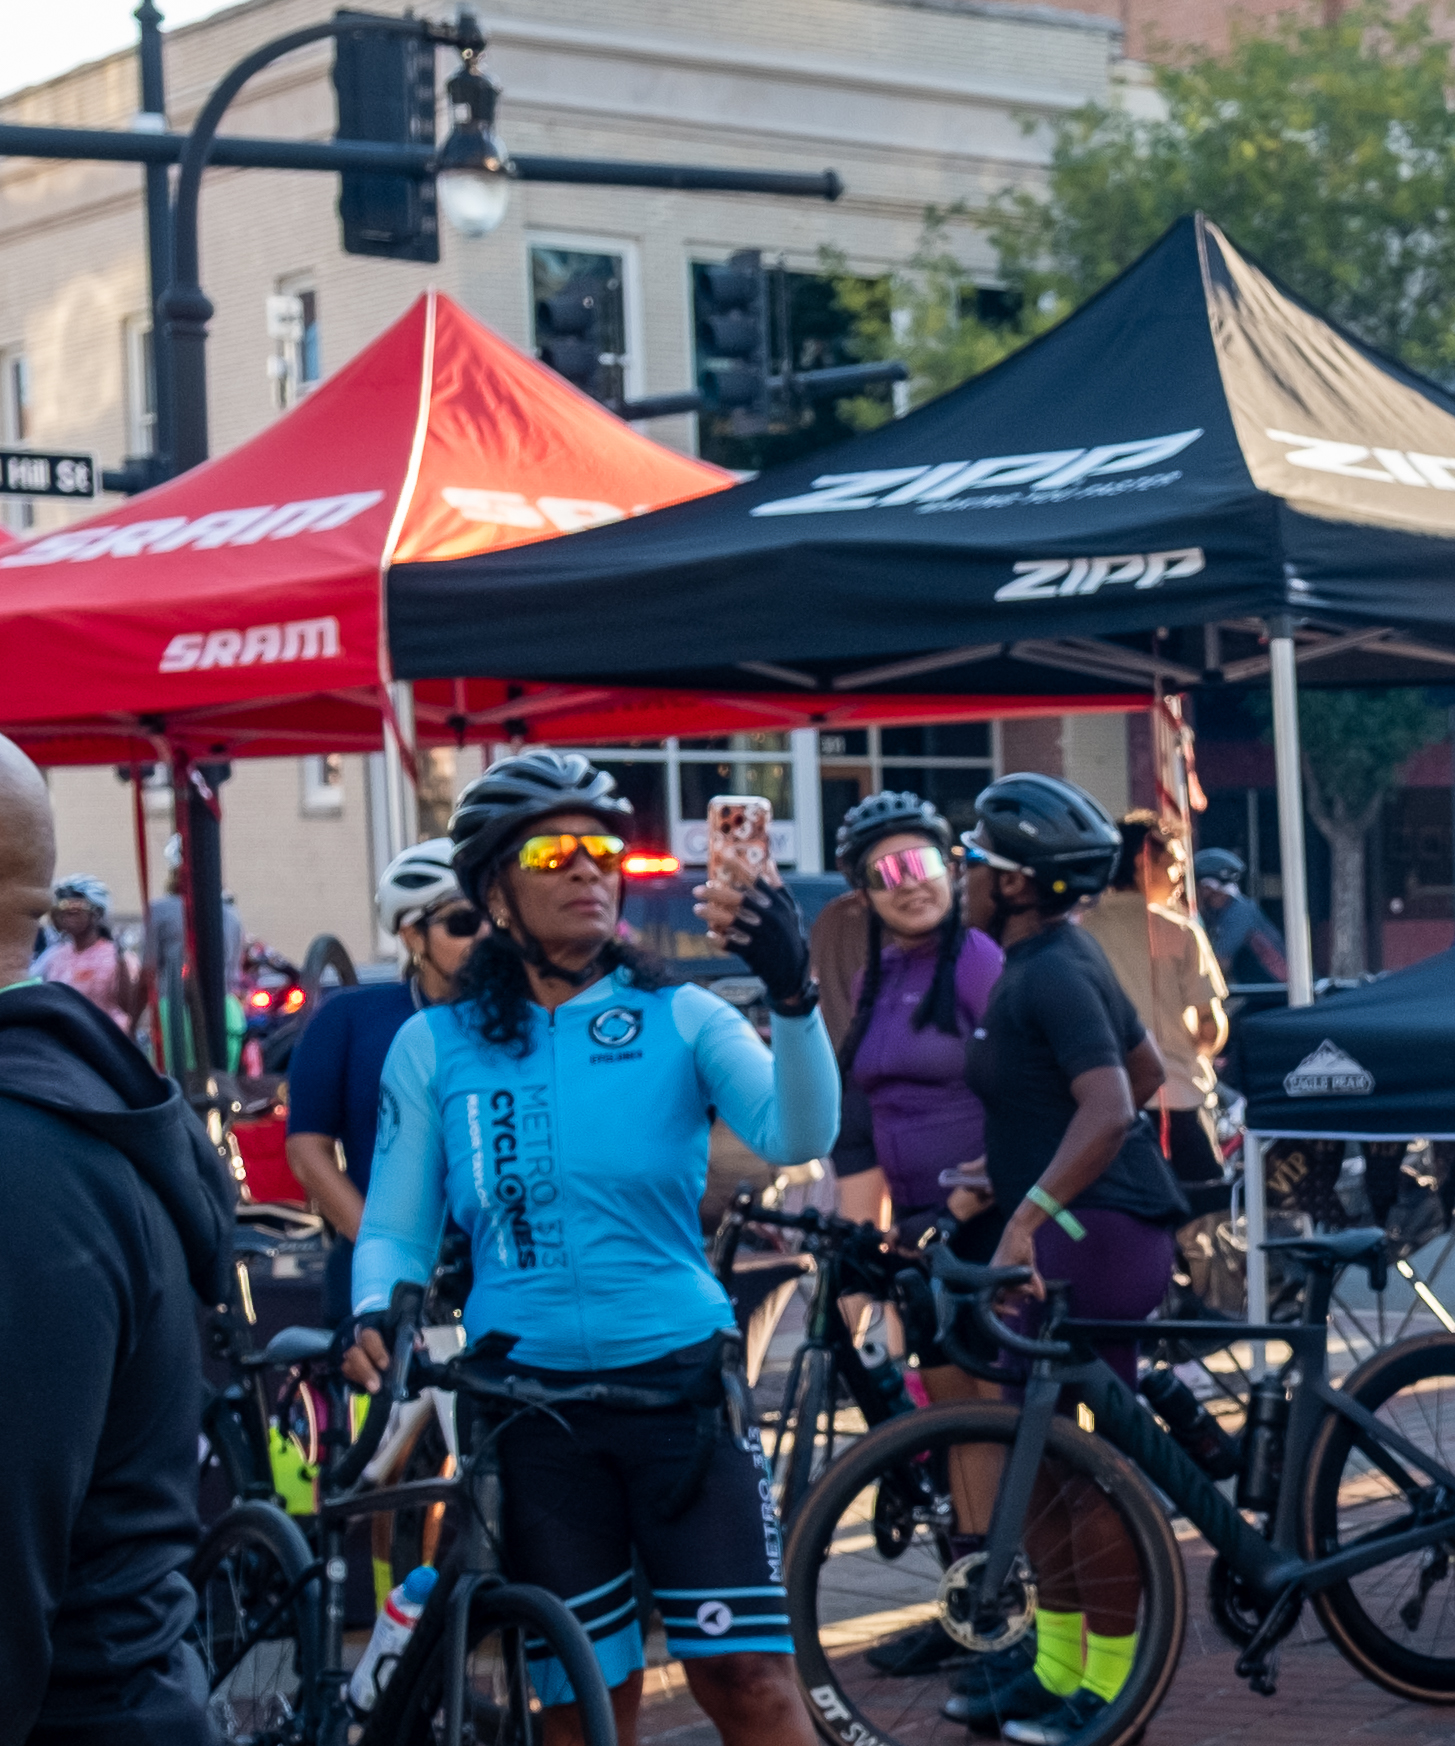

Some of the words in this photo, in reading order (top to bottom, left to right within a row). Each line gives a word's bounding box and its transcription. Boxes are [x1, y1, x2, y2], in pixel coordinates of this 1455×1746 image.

[56, 461, 92, 494] St
[752, 428, 1204, 518] ZIPP
[0, 490, 384, 568] SRAM
[995, 548, 1206, 602] ZIPP
[159, 615, 340, 674] SRAM
[489, 1088, 538, 1271] CYCLONES
[810, 1683, 850, 1725] DT
